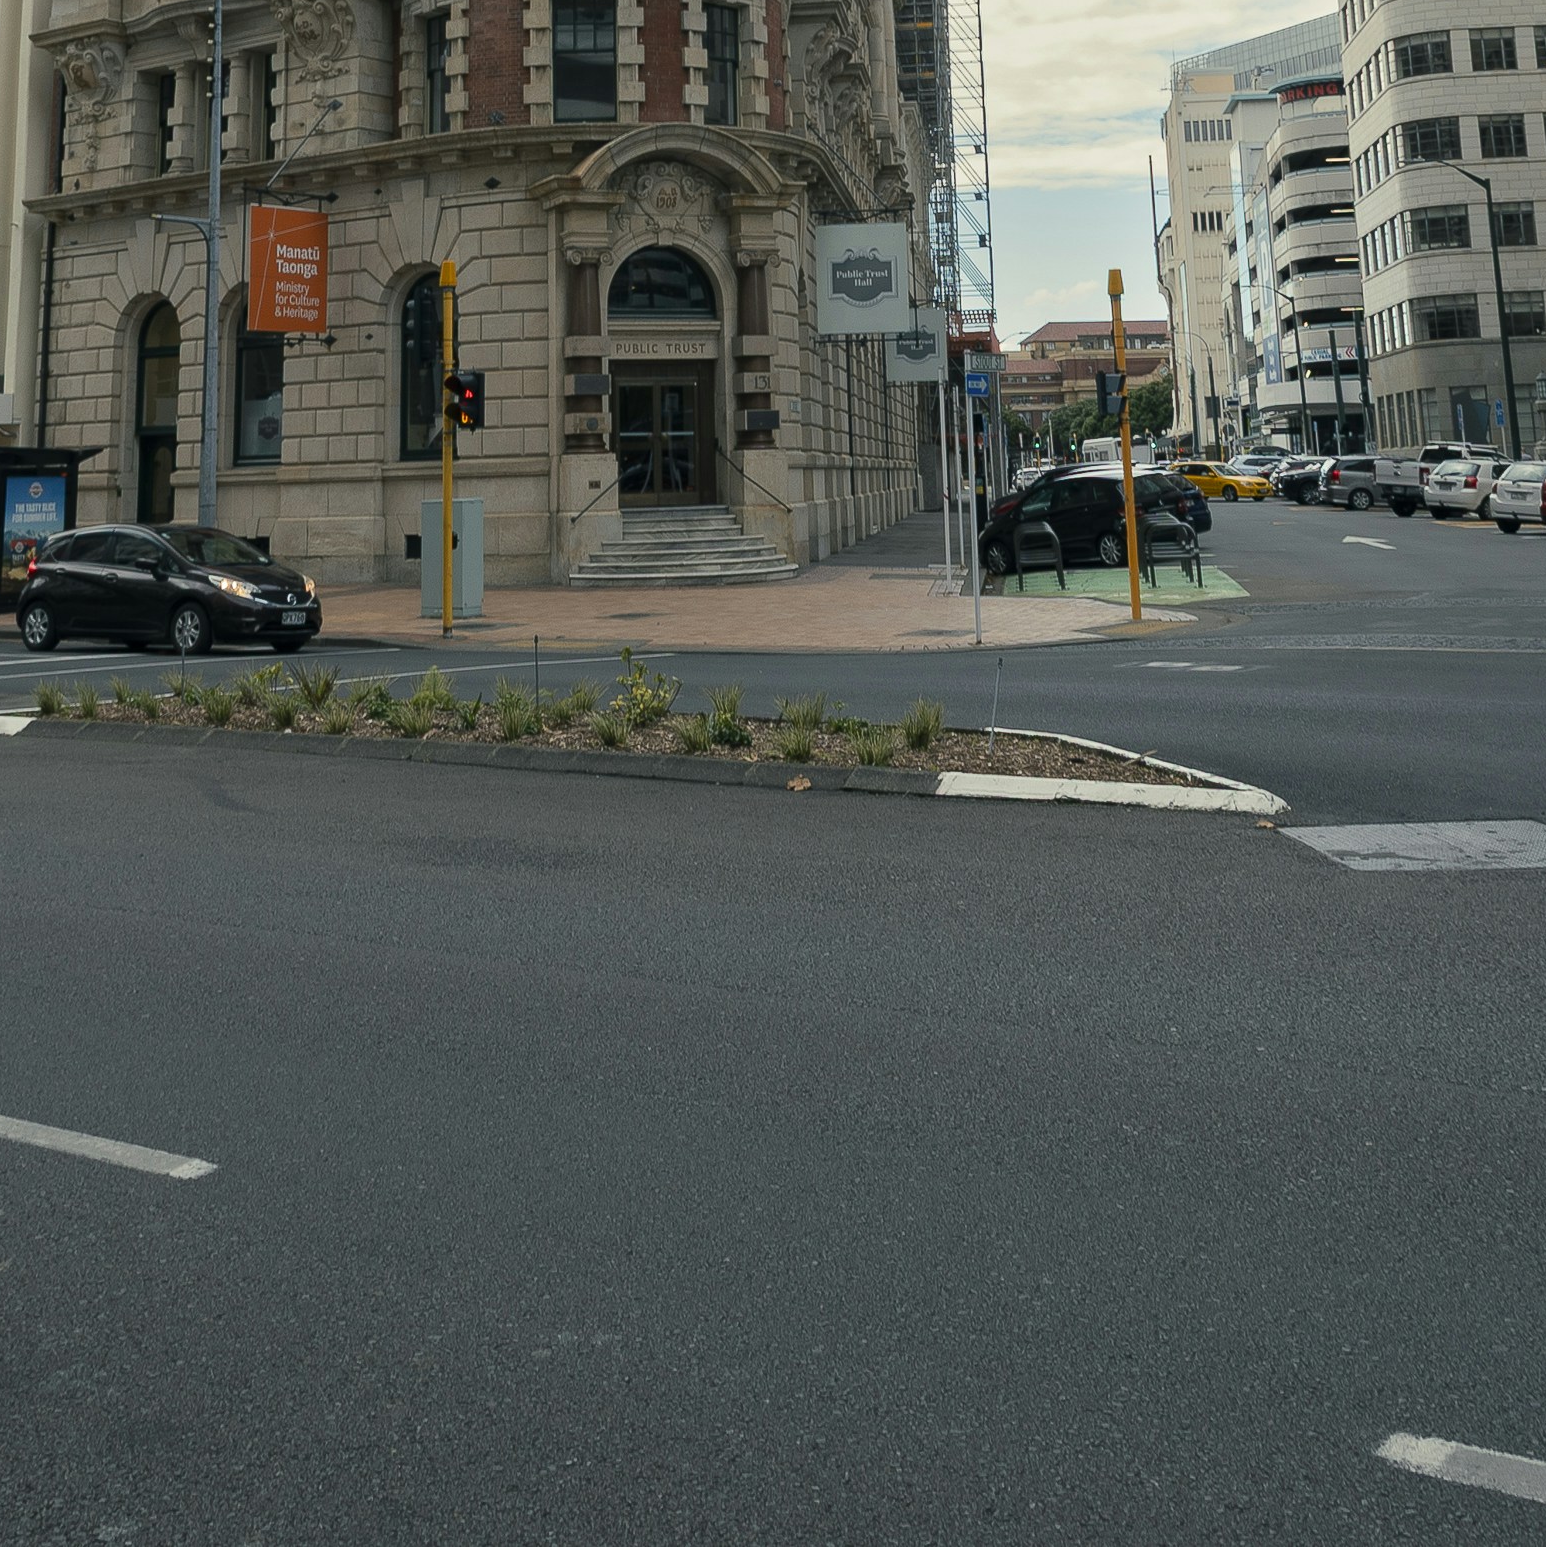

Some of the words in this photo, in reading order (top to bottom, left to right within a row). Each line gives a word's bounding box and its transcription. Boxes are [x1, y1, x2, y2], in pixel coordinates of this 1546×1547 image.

[1278, 83, 1338, 104] ARKING
[656, 197, 677, 208] 1908
[276, 243, 320, 261] Manatū
[276, 259, 318, 279] Taonga
[836, 269, 864, 279] Public
[864, 269, 889, 278] Trust
[276, 280, 310, 297] Ministry
[854, 278, 873, 287] Hall
[275, 292, 288, 305] for
[289, 294, 320, 307] Culture
[274, 306, 282, 318] &
[283, 307, 319, 322] Heritage
[616, 343, 659, 354] PUBLIC
[666, 343, 706, 354] TRUST
[755, 375, 771, 390] 131
